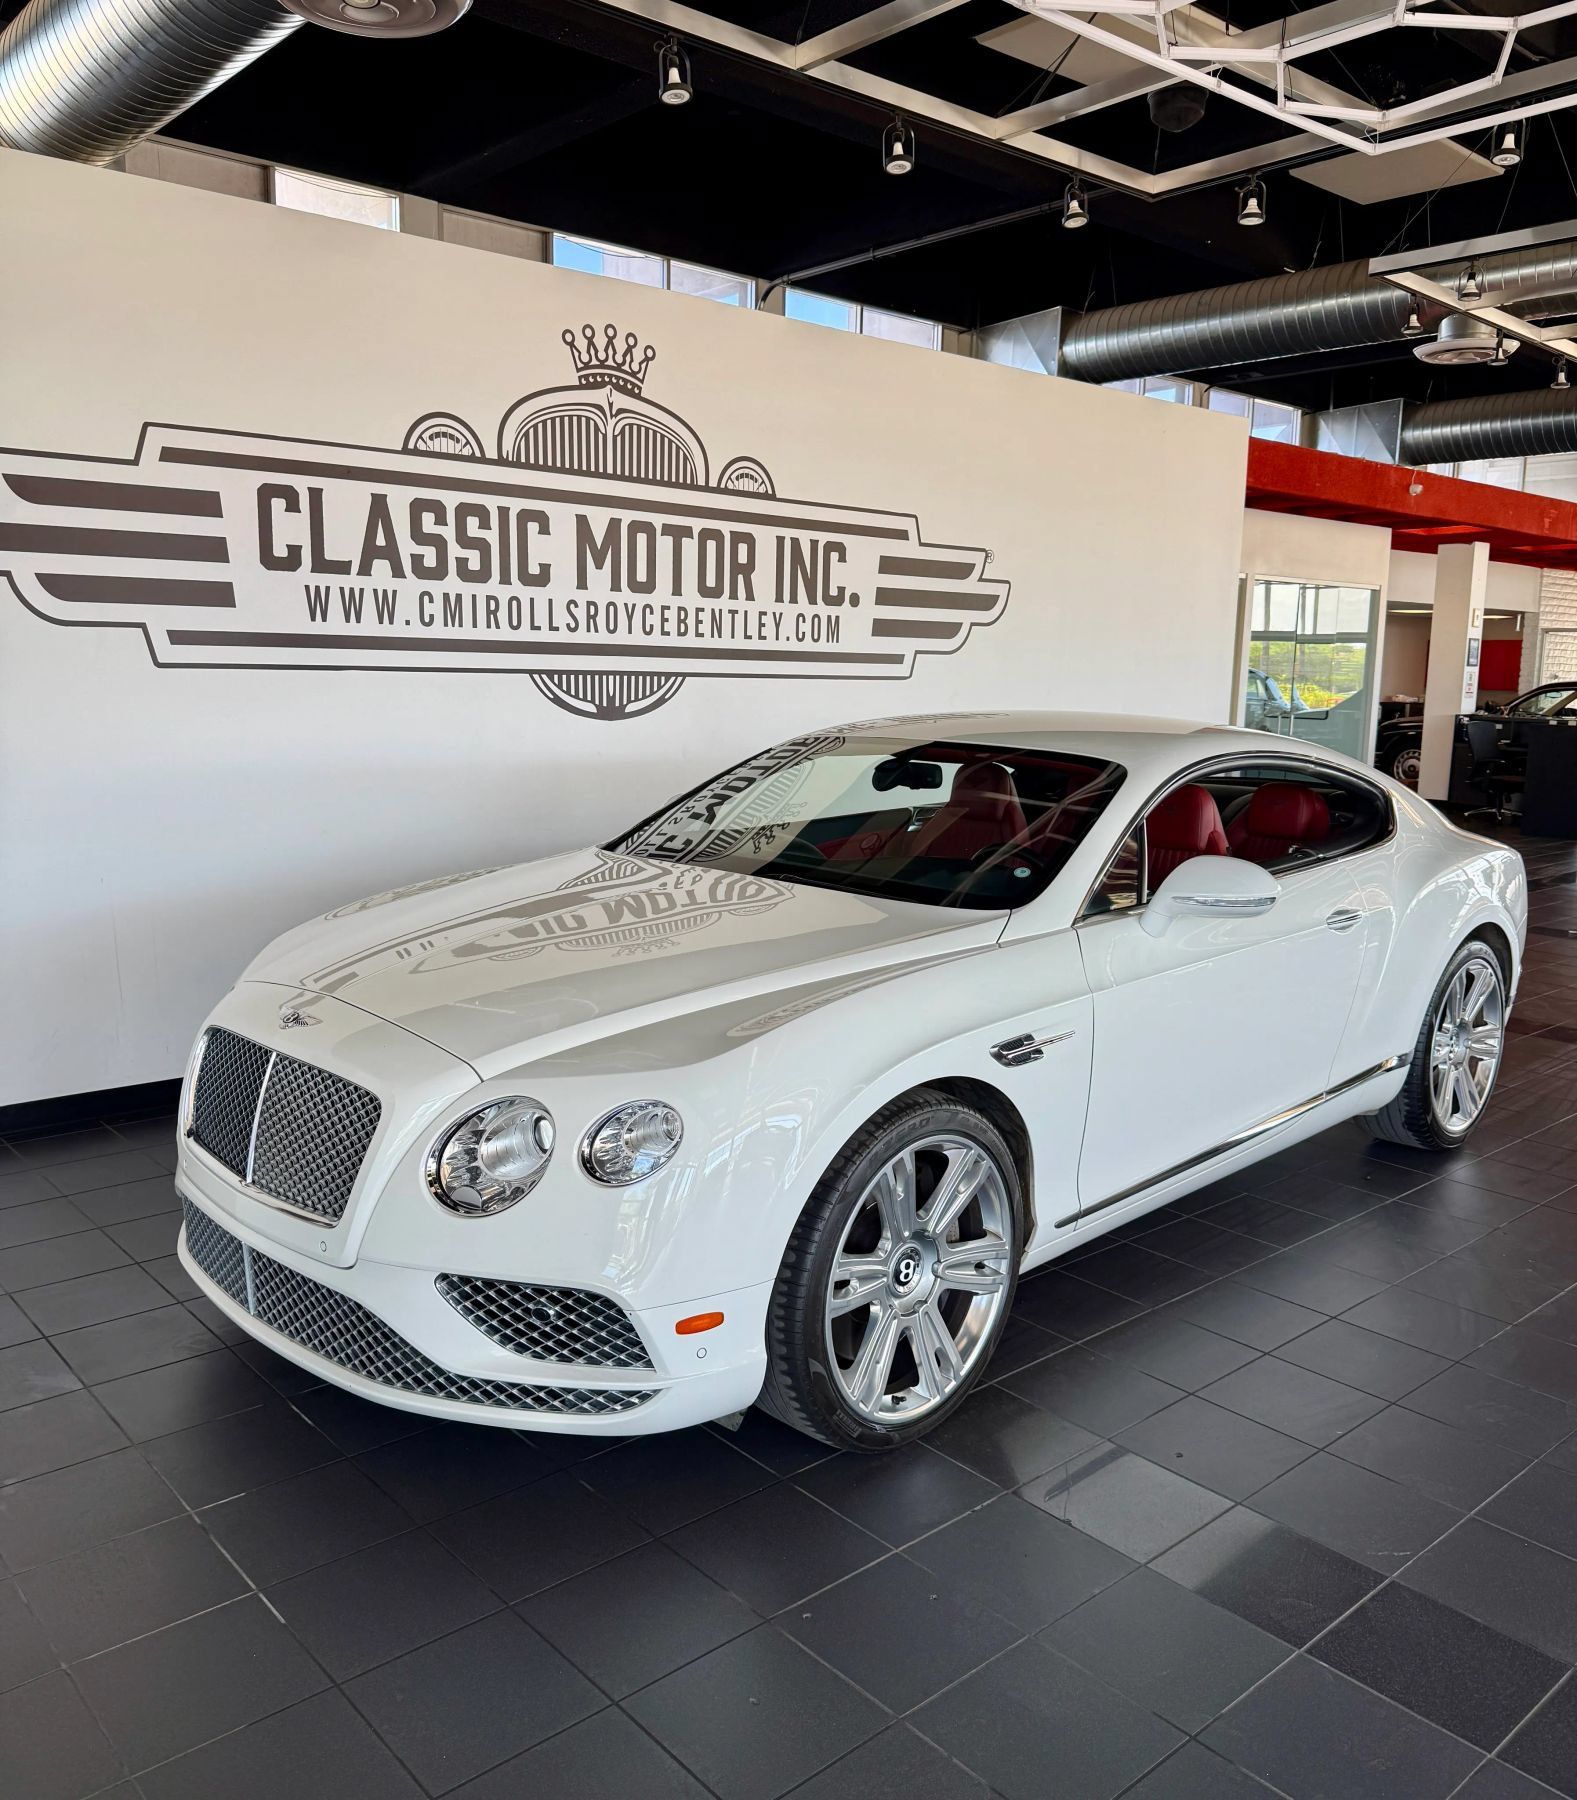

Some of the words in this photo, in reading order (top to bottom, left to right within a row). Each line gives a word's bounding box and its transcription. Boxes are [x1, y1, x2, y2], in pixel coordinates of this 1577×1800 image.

[257, 483, 551, 588] CLASSIC
[575, 513, 757, 602] MOTOR
[774, 535, 860, 608] INC.
[304, 584, 840, 643] WWW.CMIROLLSROYCEBENTLEY.COM
